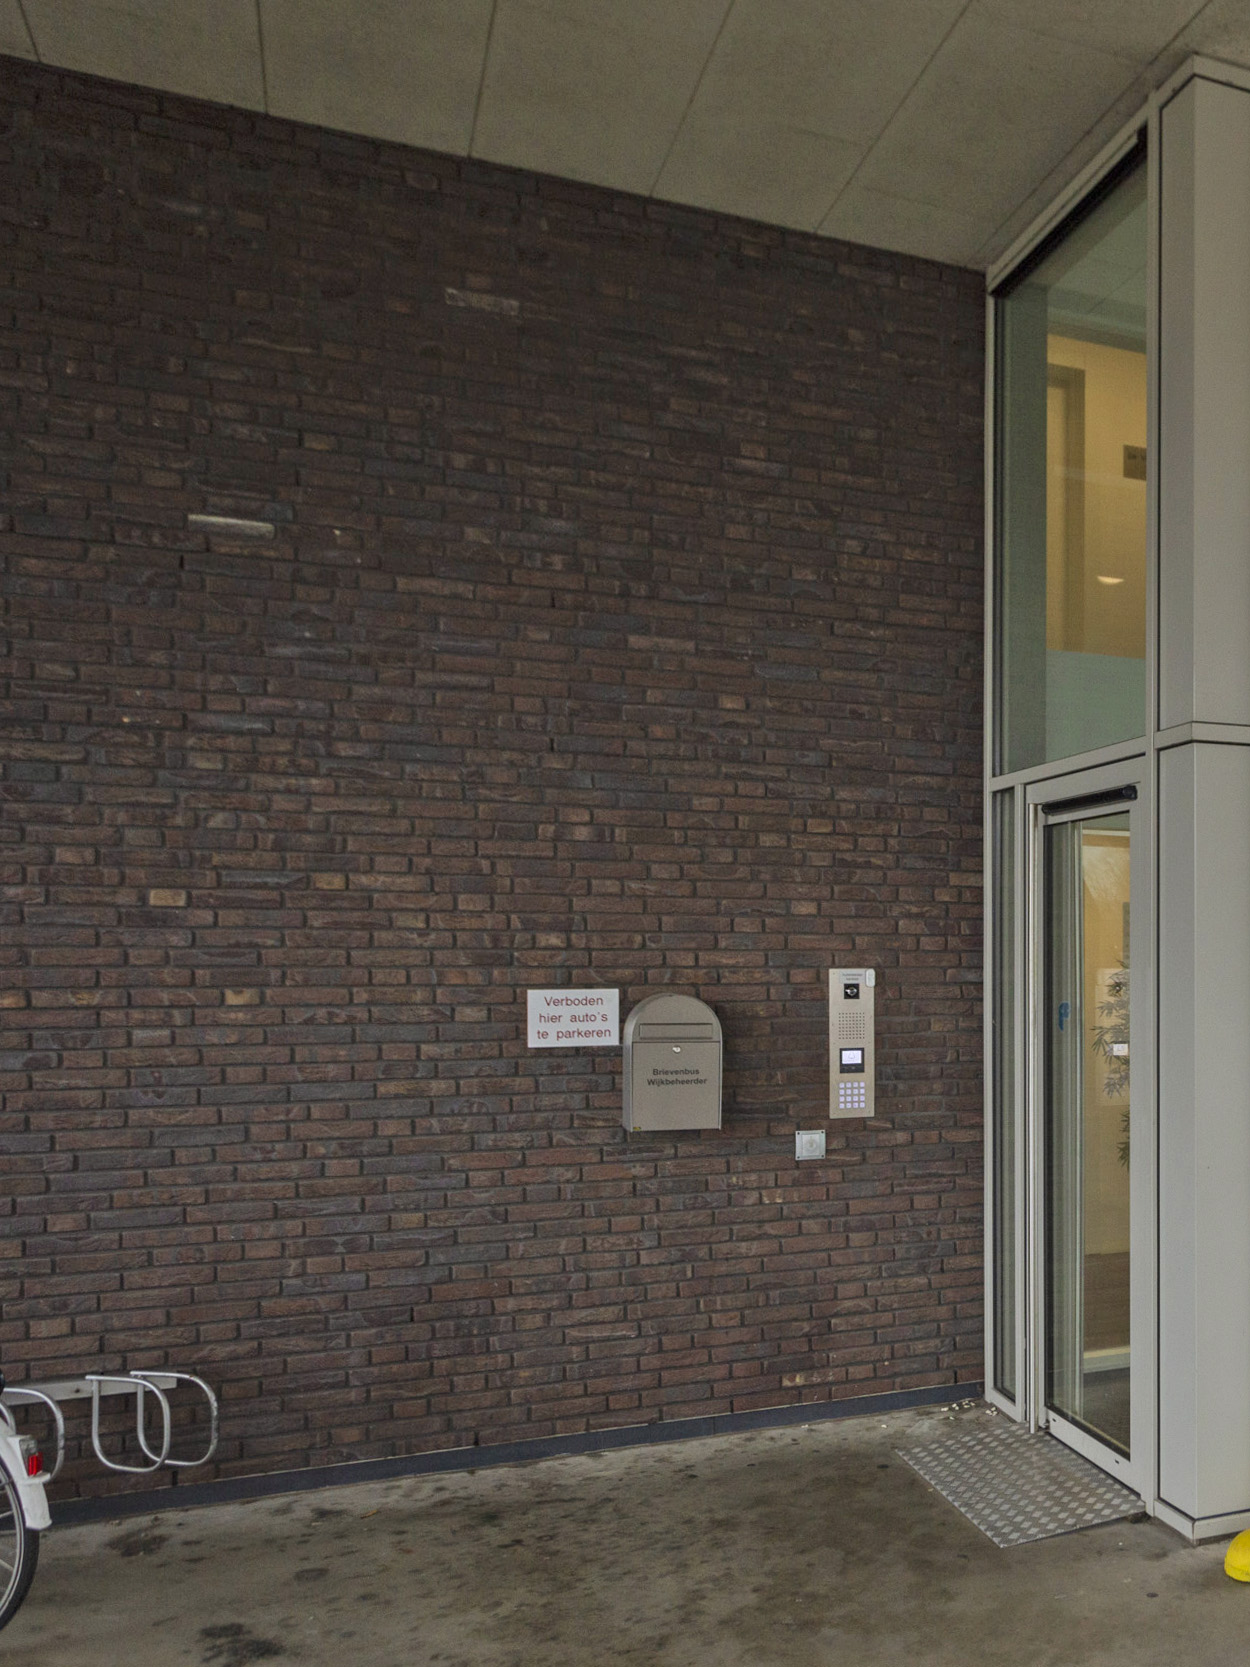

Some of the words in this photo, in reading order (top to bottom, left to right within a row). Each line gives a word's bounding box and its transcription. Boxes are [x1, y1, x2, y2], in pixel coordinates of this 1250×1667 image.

[544, 996, 604, 1007] Verboden
[538, 1013, 563, 1023] hier
[569, 1012, 608, 1023] auto's
[537, 1029, 549, 1040] te
[556, 1028, 612, 1041] parkeren
[652, 1068, 700, 1076] Brievenbus
[646, 1078, 708, 1087] Wijkbeheerder
